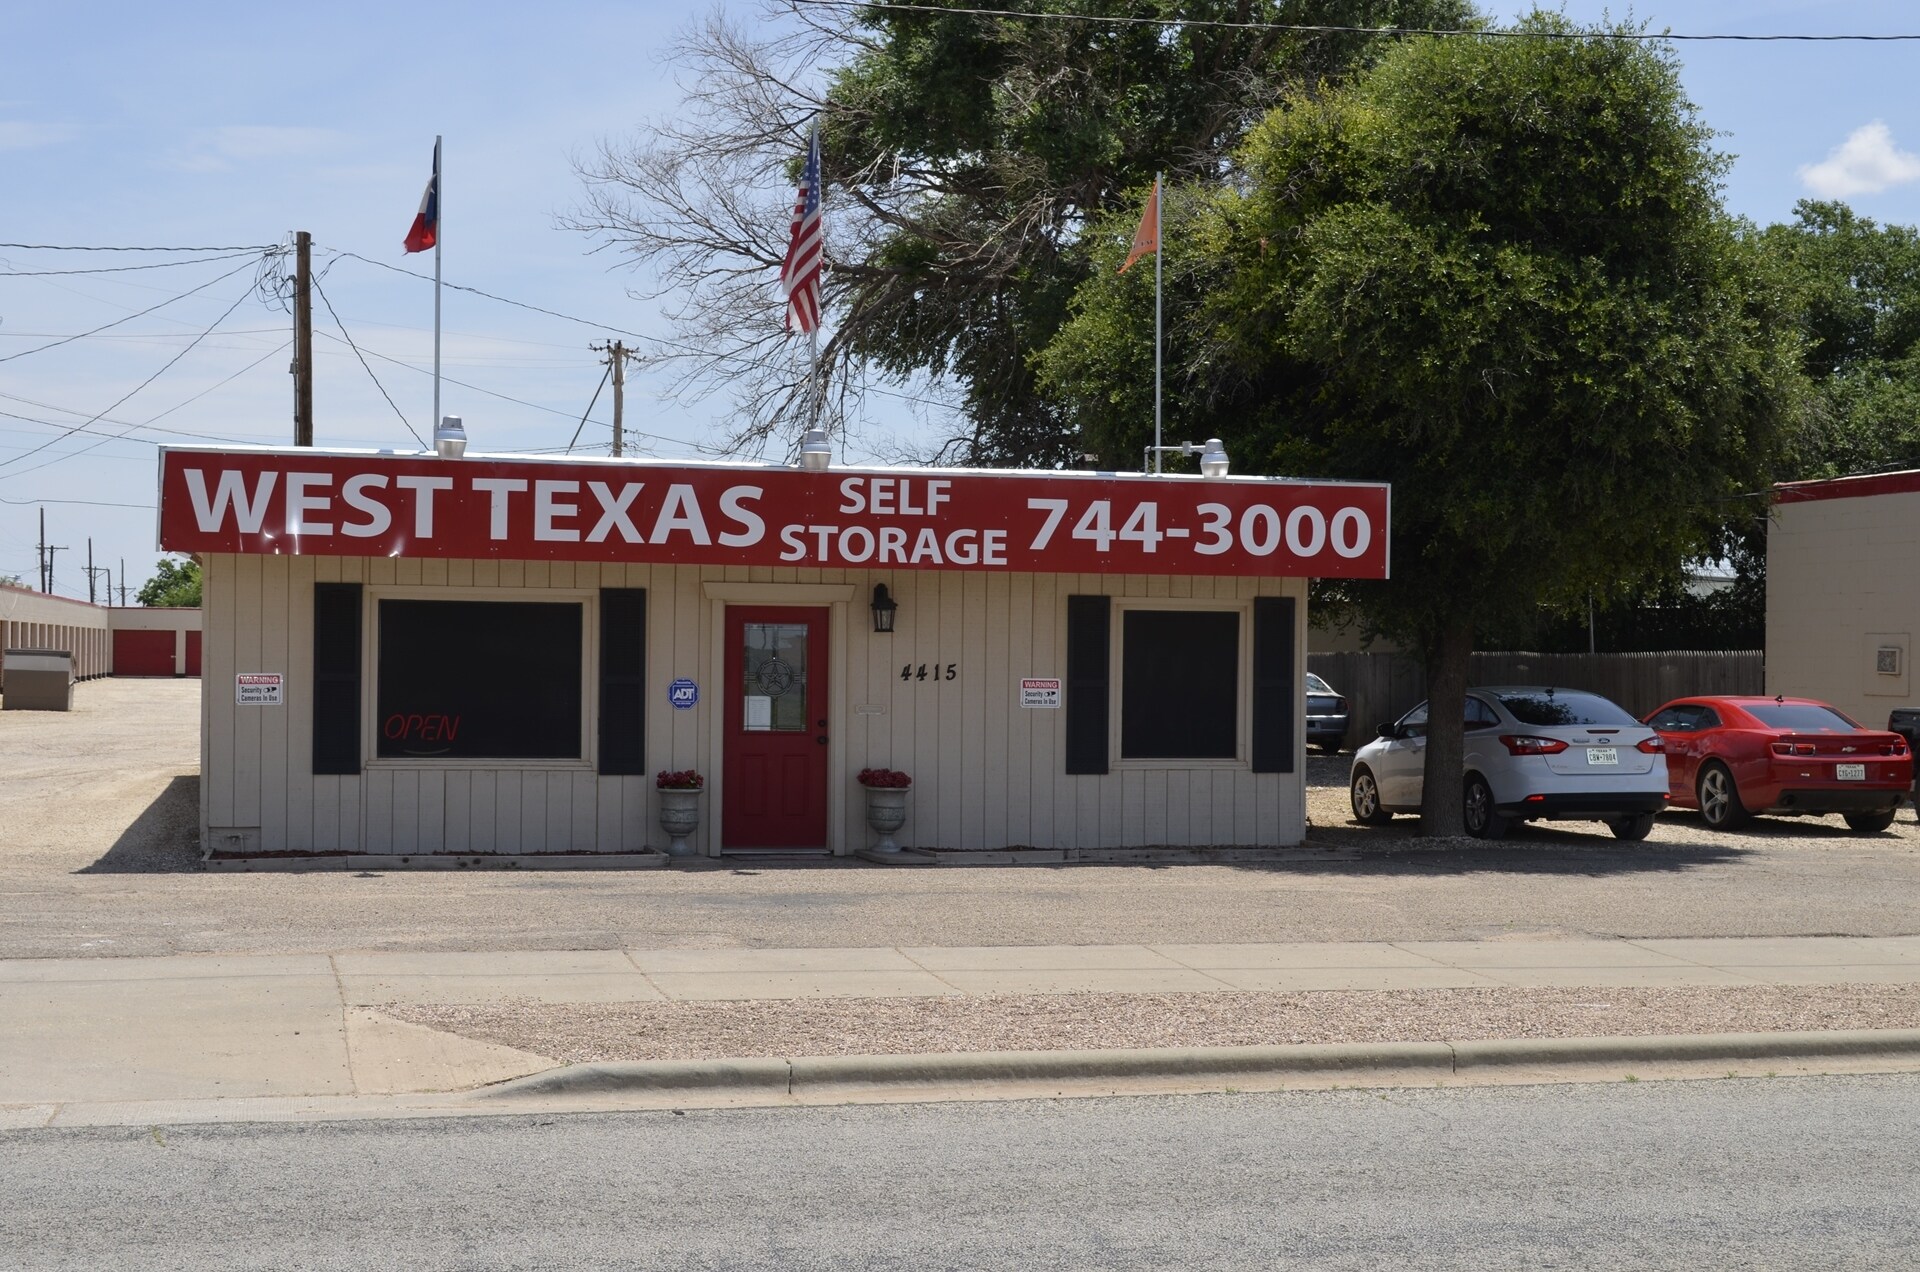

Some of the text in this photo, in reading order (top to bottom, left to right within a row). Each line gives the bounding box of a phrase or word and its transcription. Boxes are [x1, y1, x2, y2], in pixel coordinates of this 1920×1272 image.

[184, 469, 766, 547] WEST TEXAS
[840, 477, 952, 516] SELF
[1028, 498, 1371, 558] 744-3000
[780, 524, 1008, 565] STORAGE
[240, 676, 279, 684] WARNING
[900, 663, 957, 681] 4415
[241, 686, 262, 695] Security
[674, 688, 694, 700] ADT
[1024, 690, 1043, 698] Security
[384, 713, 461, 742] OPEN
